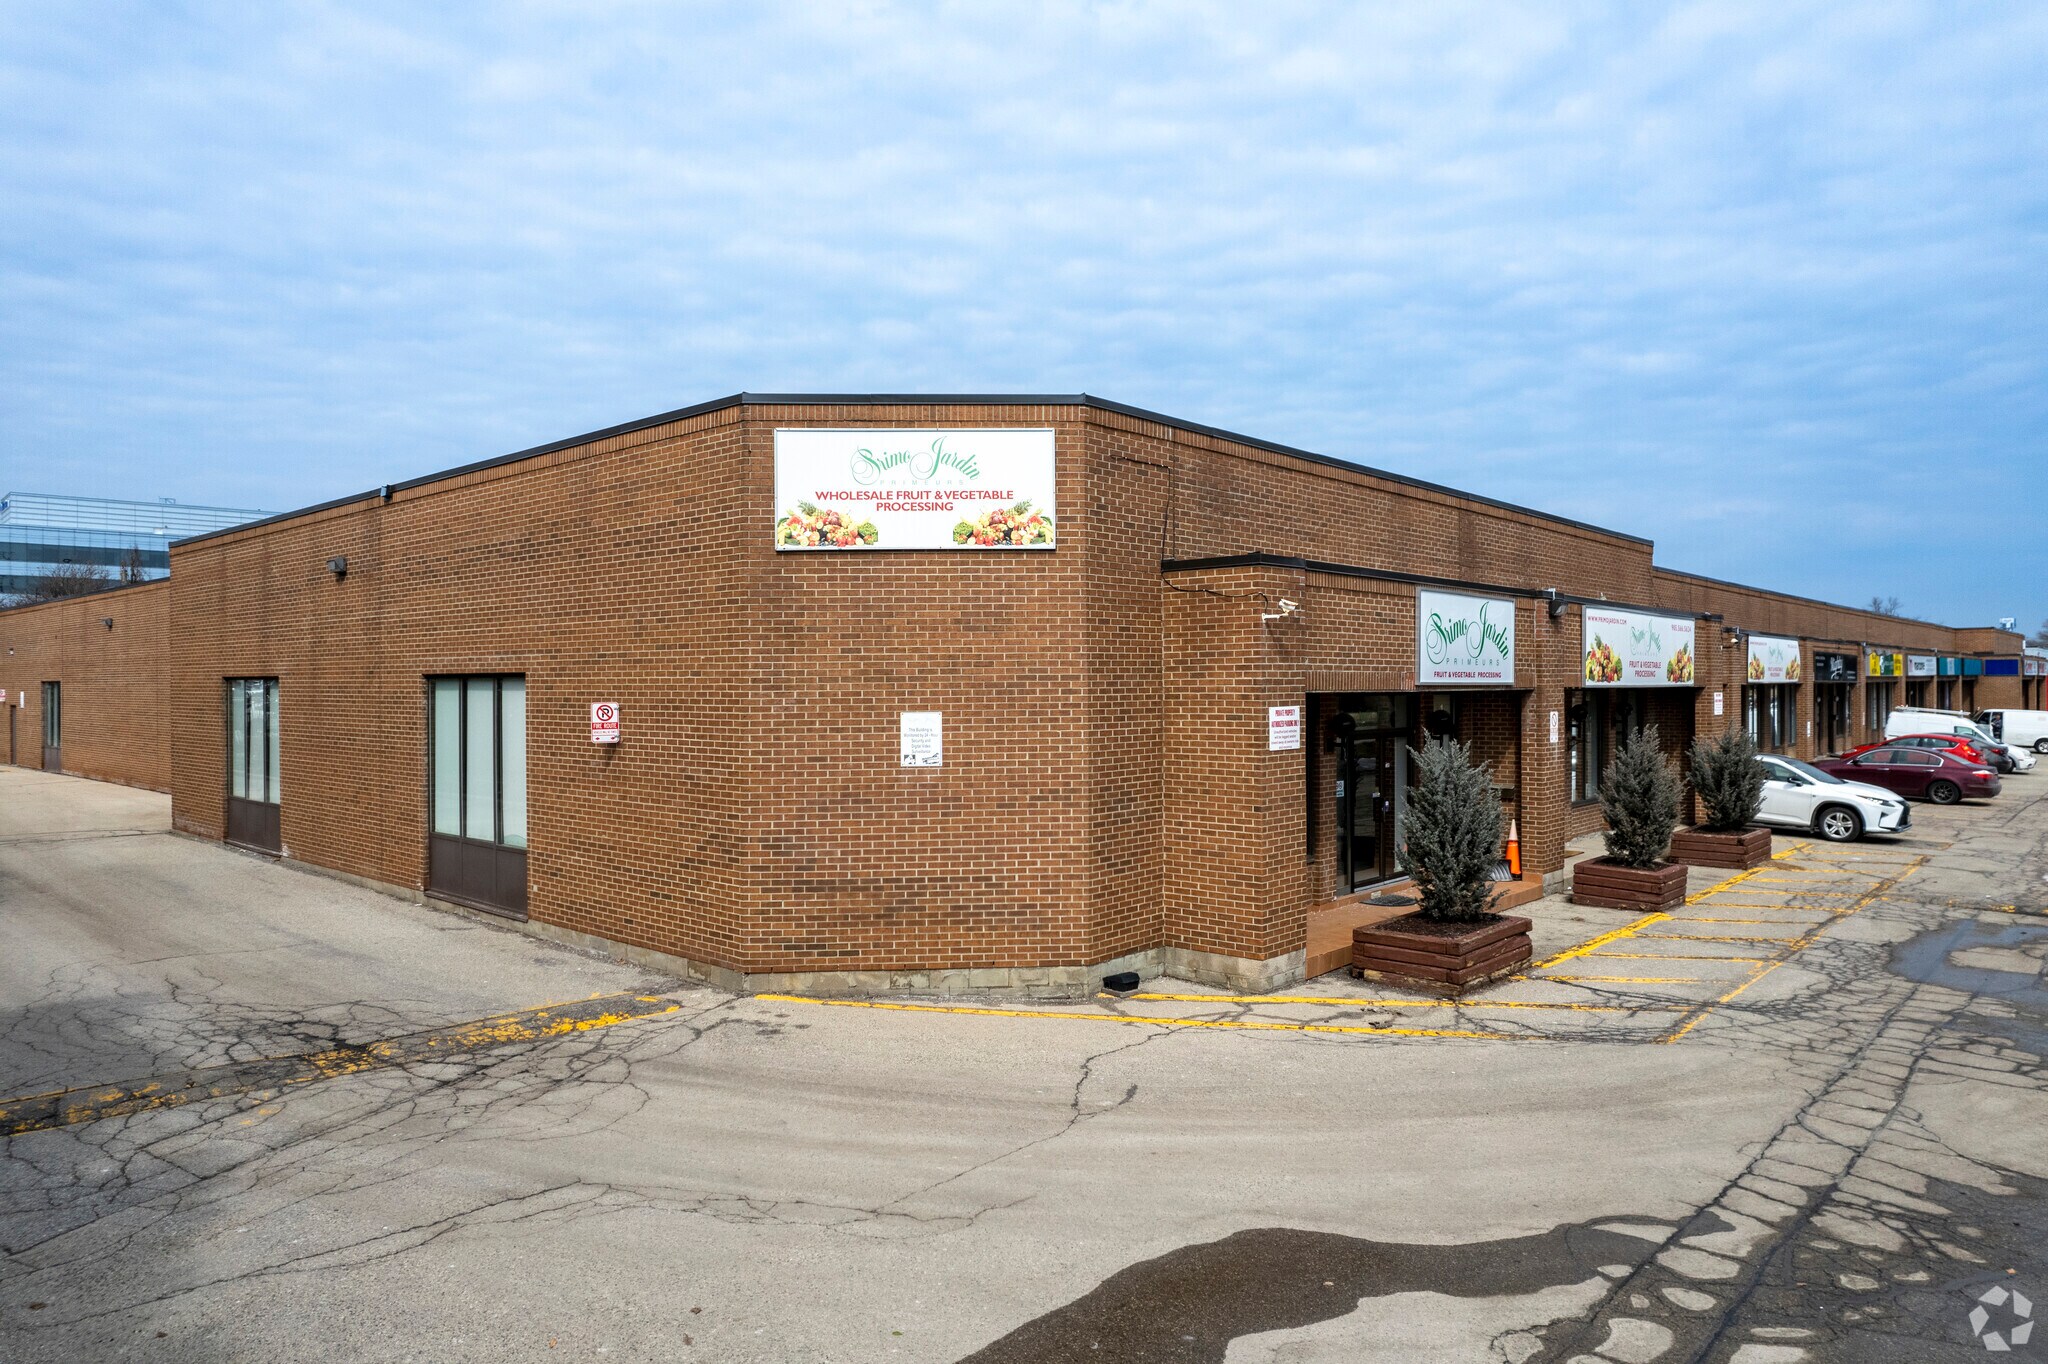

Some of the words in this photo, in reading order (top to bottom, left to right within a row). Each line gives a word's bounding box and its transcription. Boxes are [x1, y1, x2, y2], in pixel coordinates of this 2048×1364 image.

[909, 435, 981, 481] Jardin
[815, 490, 894, 501] WHOLESALE
[896, 490, 932, 500] FRUIT
[934, 490, 944, 500] &
[943, 490, 1014, 500] VEGETABLE
[876, 501, 954, 512] PROCESSING
[1425, 608, 1468, 665] Primo
[1466, 601, 1509, 660] Jardin
[1446, 657, 1500, 667] PRIMEURS
[1628, 660, 1640, 668] FRUIT
[1643, 661, 1662, 669] VEGETABLE
[1634, 670, 1656, 678] PROCESSING
